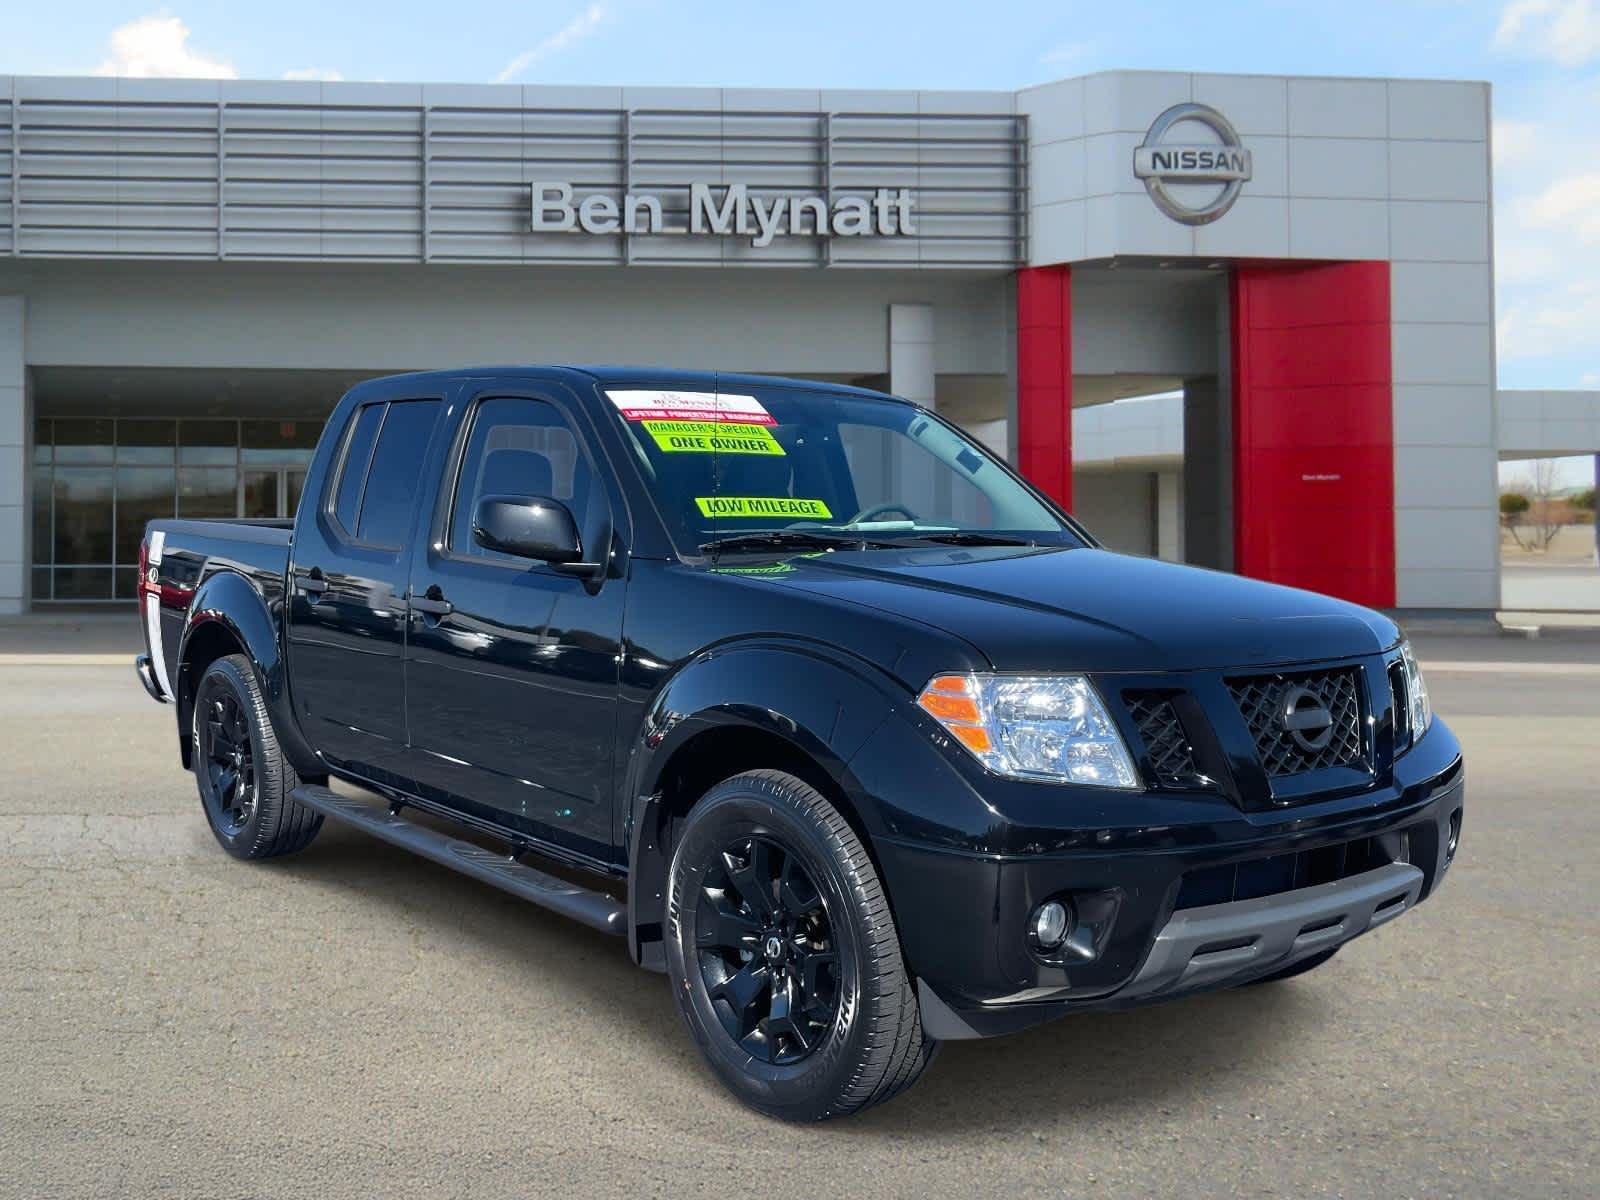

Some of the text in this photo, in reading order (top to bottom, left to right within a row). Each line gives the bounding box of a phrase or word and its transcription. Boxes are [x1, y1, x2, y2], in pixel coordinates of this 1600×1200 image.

[1151, 151, 1244, 173] NISSAN
[531, 181, 917, 248] Ben Mynatt
[648, 422, 764, 435] MANAGER'S SPECIAL
[669, 436, 769, 451] ONE OWNER
[705, 499, 821, 514] LOW MILEAGE
